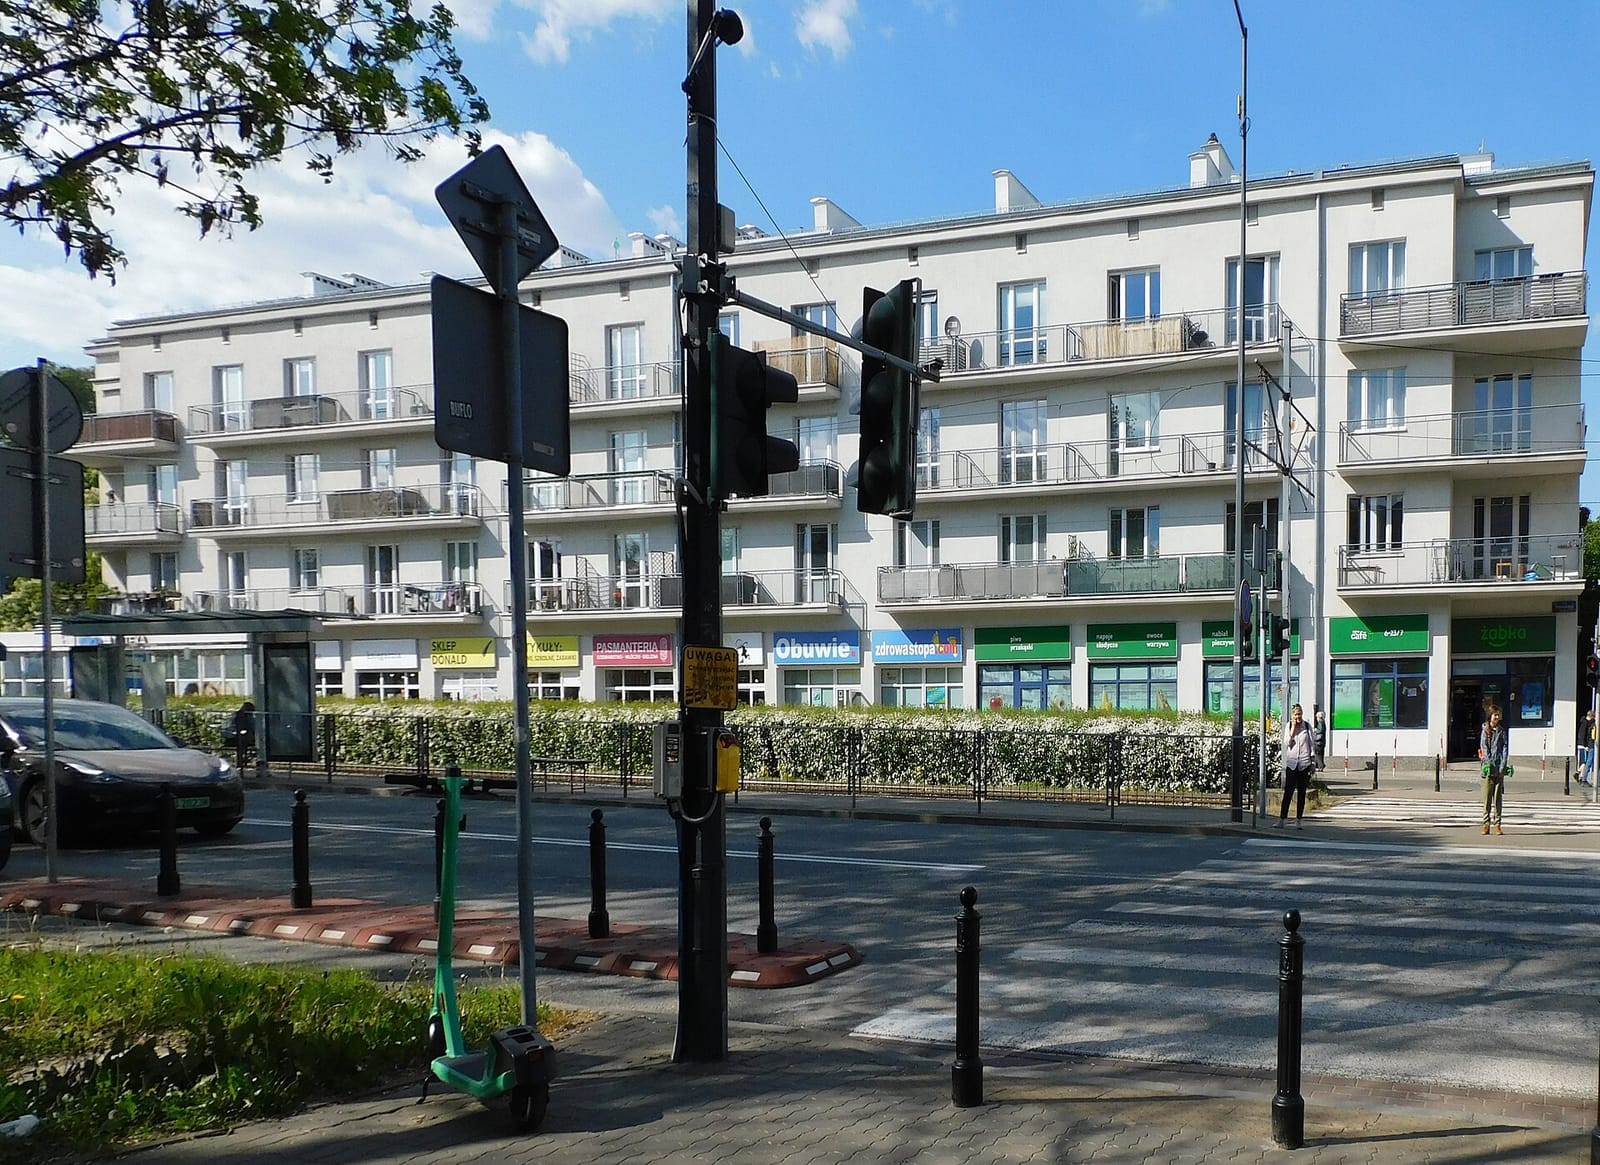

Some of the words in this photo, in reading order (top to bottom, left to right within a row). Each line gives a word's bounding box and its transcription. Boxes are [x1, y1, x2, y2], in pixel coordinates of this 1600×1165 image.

[1096, 633, 1113, 641] napoje
[1480, 625, 1527, 641] żabka
[432, 641, 456, 651] SKLEP
[596, 642, 658, 653] PASMANTERIA
[1146, 641, 1169, 649] warzywa
[1211, 639, 1235, 648] pieczyw
[432, 654, 467, 665] DONALD
[686, 649, 736, 663] UWAGA!
